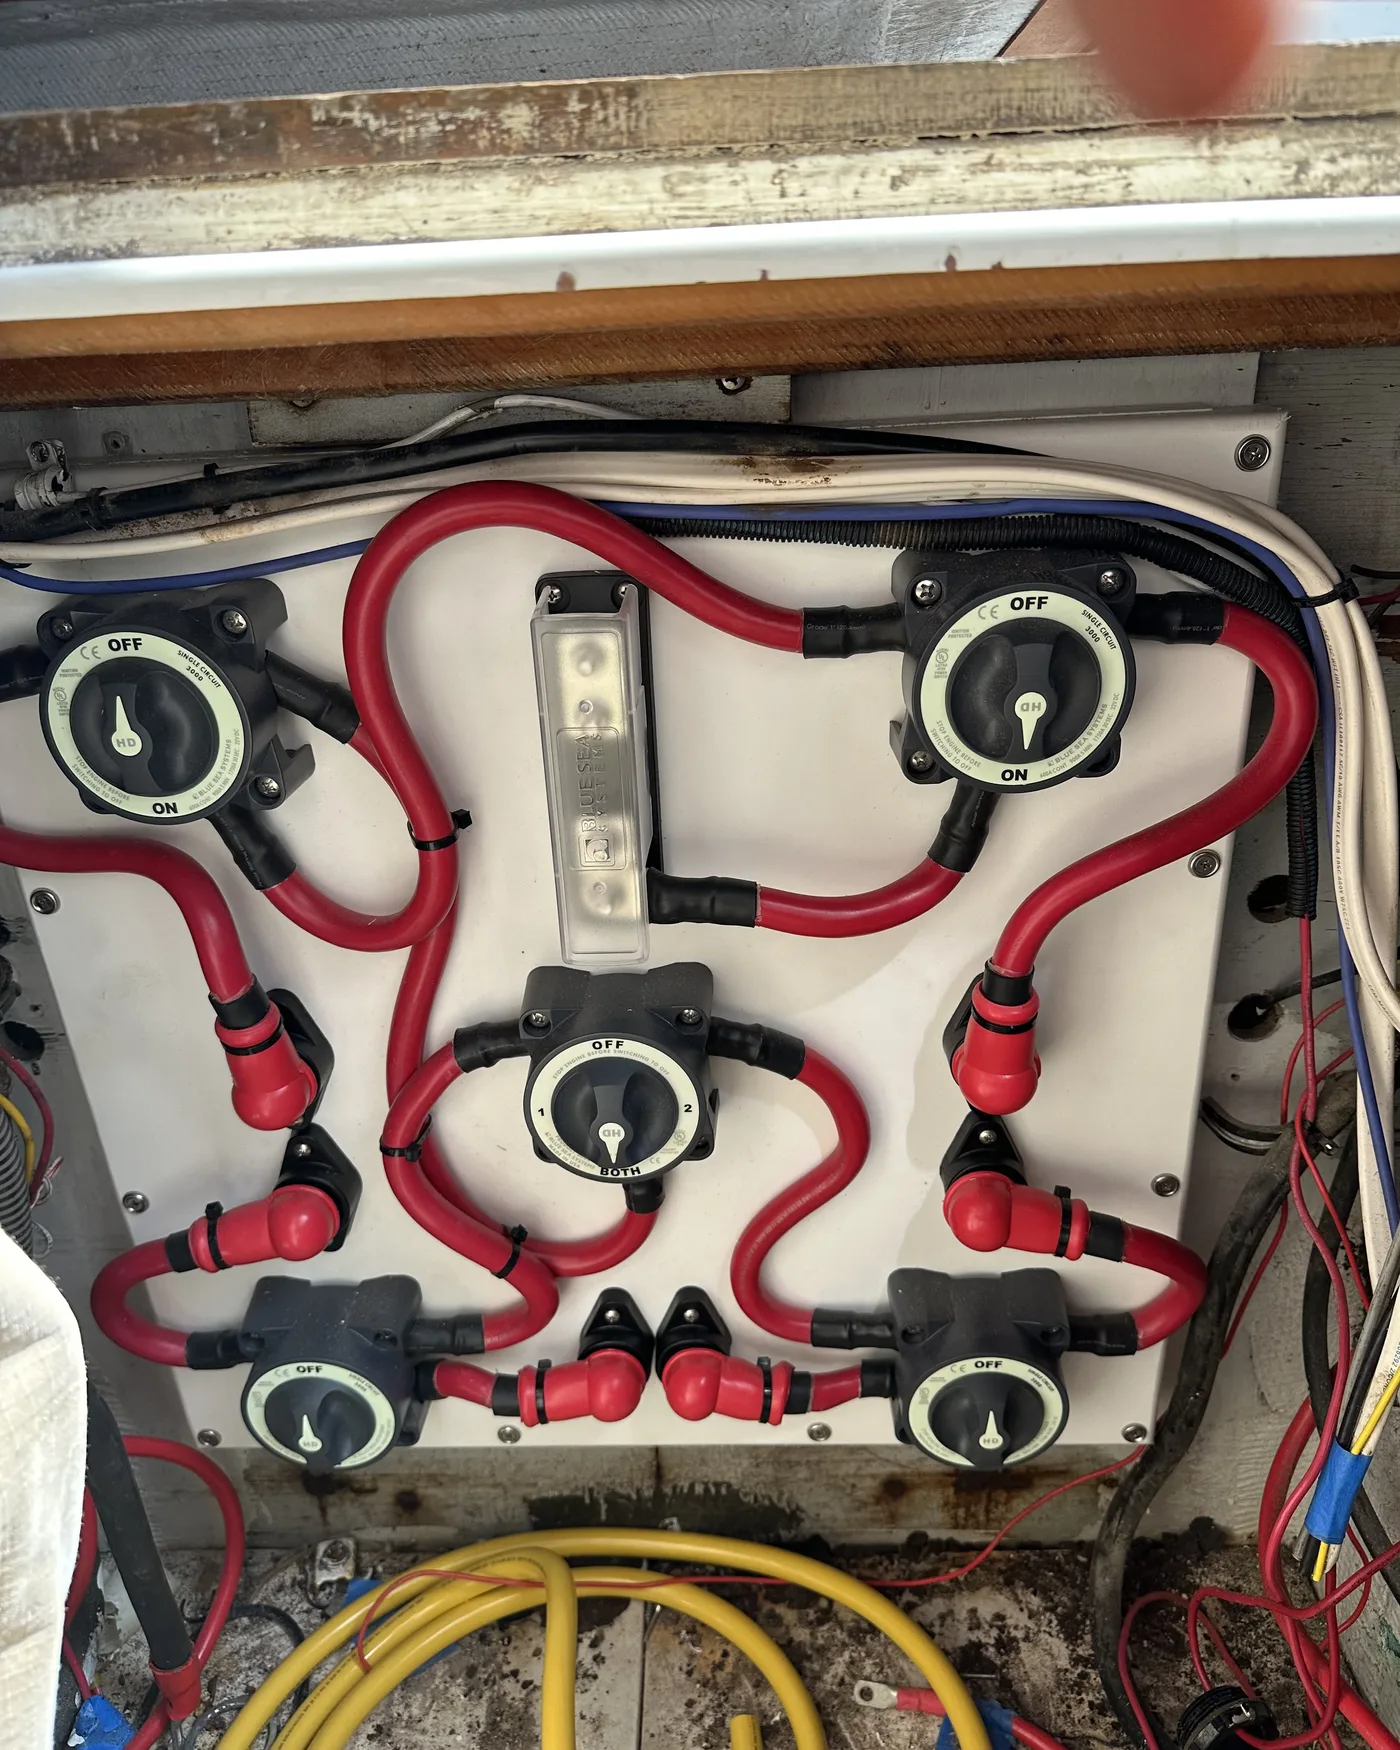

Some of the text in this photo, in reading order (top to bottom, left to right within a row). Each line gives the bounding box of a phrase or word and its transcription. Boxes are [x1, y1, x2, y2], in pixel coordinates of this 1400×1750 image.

[1010, 596, 1048, 610] OFF
[978, 604, 999, 619] CE
[1081, 609, 1117, 650] SINGLE CIRCUIT
[1085, 626, 1100, 642] 3000
[108, 637, 142, 652] OFF
[80, 645, 101, 660] CE
[177, 649, 221, 688] SINGLE CIRCUIT
[185, 665, 204, 682] 3000
[1020, 702, 1041, 712] HD
[1055, 703, 1108, 764] BLUE SEA SYSTEMS
[116, 738, 137, 748] HD
[930, 728, 972, 772] SWITCHING TO OFF
[936, 720, 982, 768] STOP ENGINE BEFORE
[200, 738, 232, 797] BLUE SEA SYSTEMS
[1001, 769, 1028, 781] ON
[72, 763, 123, 805] SWITCHING TO OFF
[75, 755, 130, 801] STOP ENGINE BEFORE
[575, 734, 597, 832] BLUE SEA
[152, 802, 178, 814] ON
[592, 1040, 624, 1050] OFF
[552, 1066, 564, 1079] STOP
[564, 1053, 586, 1067] ENGINE
[613, 1049, 650, 1061] SWITCHING
[659, 1066, 670, 1075] OFF
[538, 1108, 545, 1116] 1
[684, 1104, 692, 1112] 2
[602, 1129, 621, 1137] HD
[561, 1148, 572, 1158] SEA
[569, 1160, 580, 1168] USA
[600, 1167, 641, 1176] BOTH
[950, 1364, 967, 1373] CE
[974, 1360, 1003, 1368] OFF
